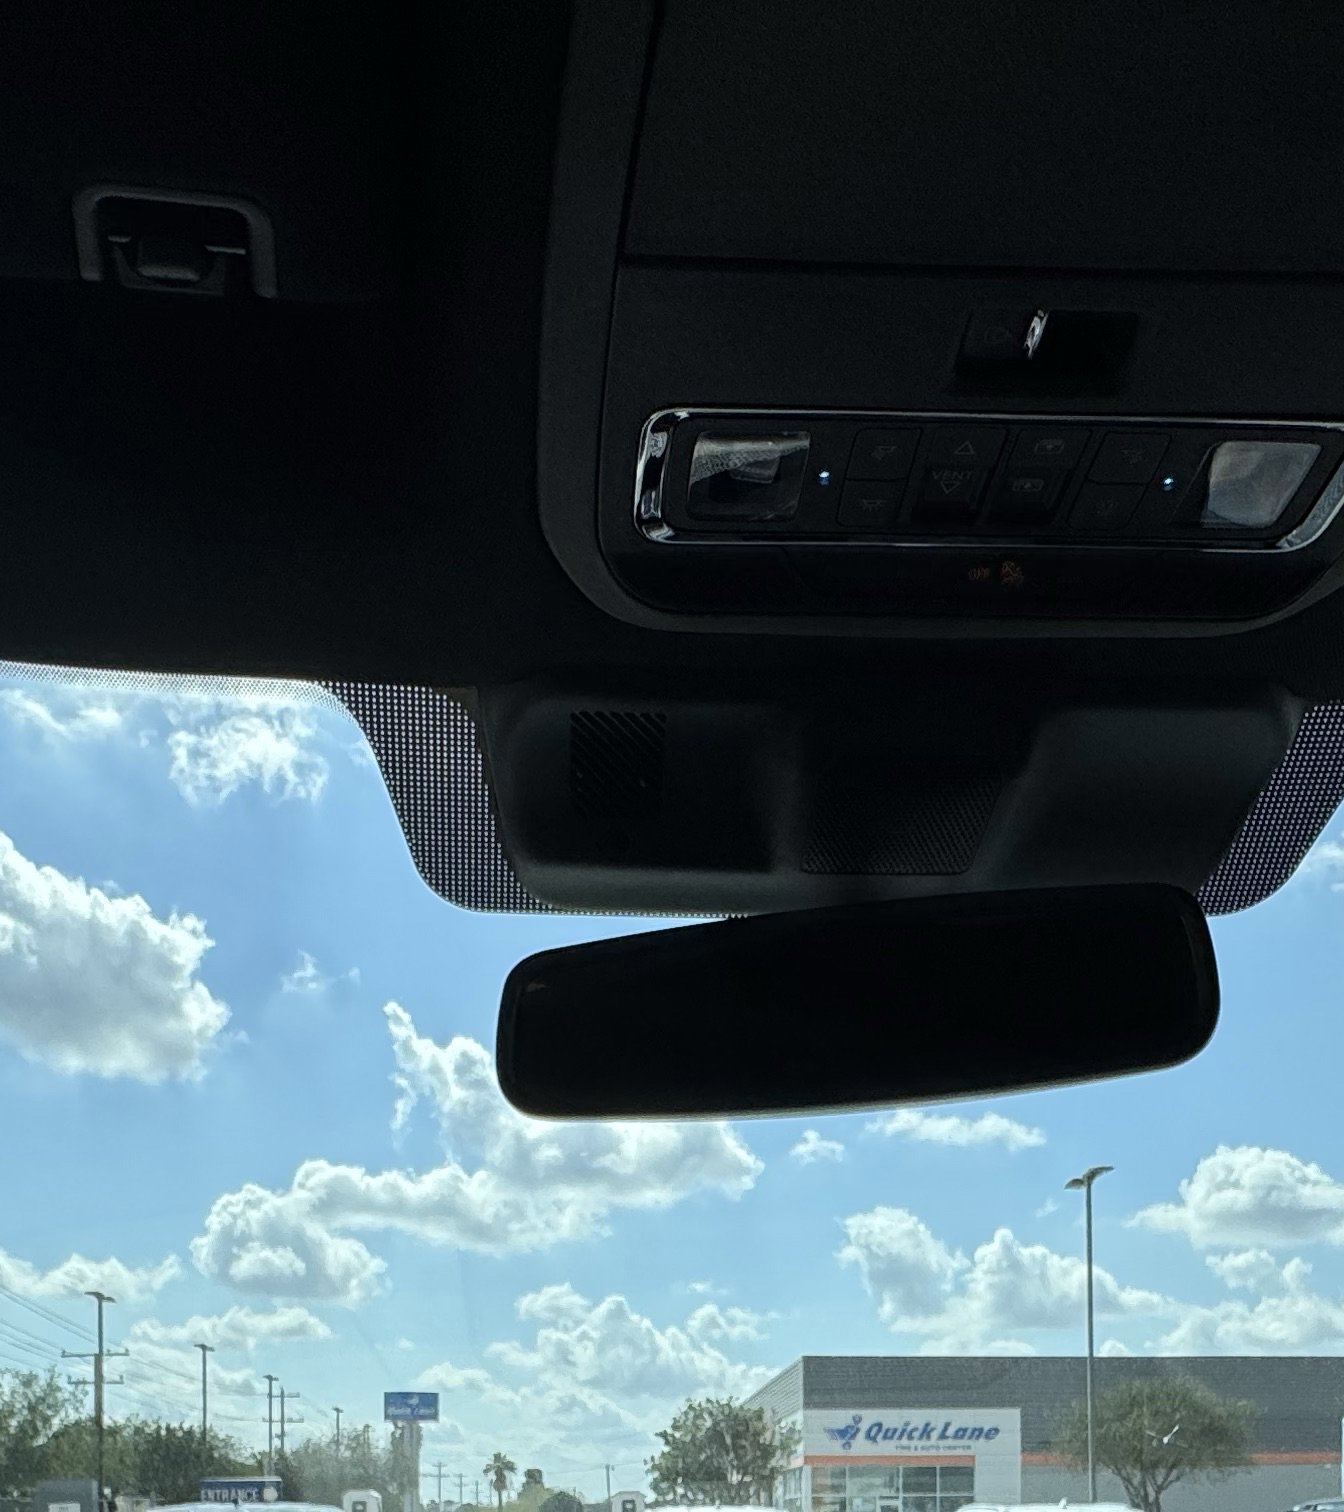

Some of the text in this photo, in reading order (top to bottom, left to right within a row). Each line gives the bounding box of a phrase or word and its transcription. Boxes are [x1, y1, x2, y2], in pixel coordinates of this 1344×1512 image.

[930, 470, 975, 484] VENT
[865, 1421, 1000, 1445] Quick Lane
[200, 1487, 258, 1502] ENTRANCE
